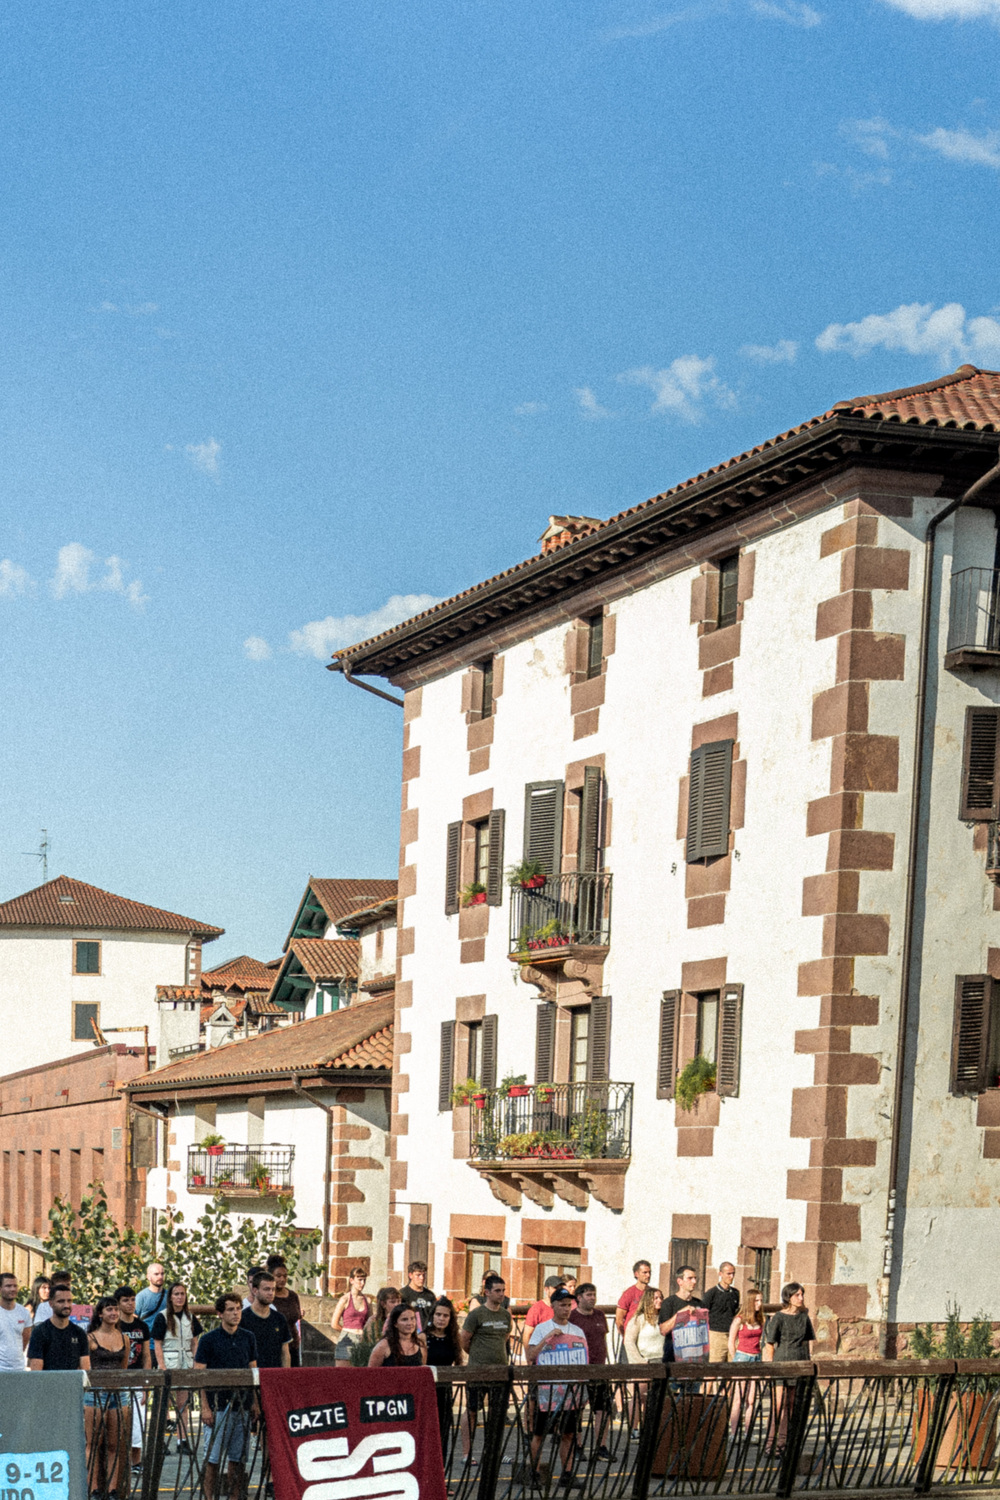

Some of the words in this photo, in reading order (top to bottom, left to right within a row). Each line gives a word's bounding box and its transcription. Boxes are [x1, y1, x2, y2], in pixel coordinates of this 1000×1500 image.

[539, 1349, 585, 1365] SOZIALISTA
[289, 1407, 345, 1432] GAZTE
[366, 1400, 408, 1417] TPGN
[5, 1461, 63, 1484] 9-12
